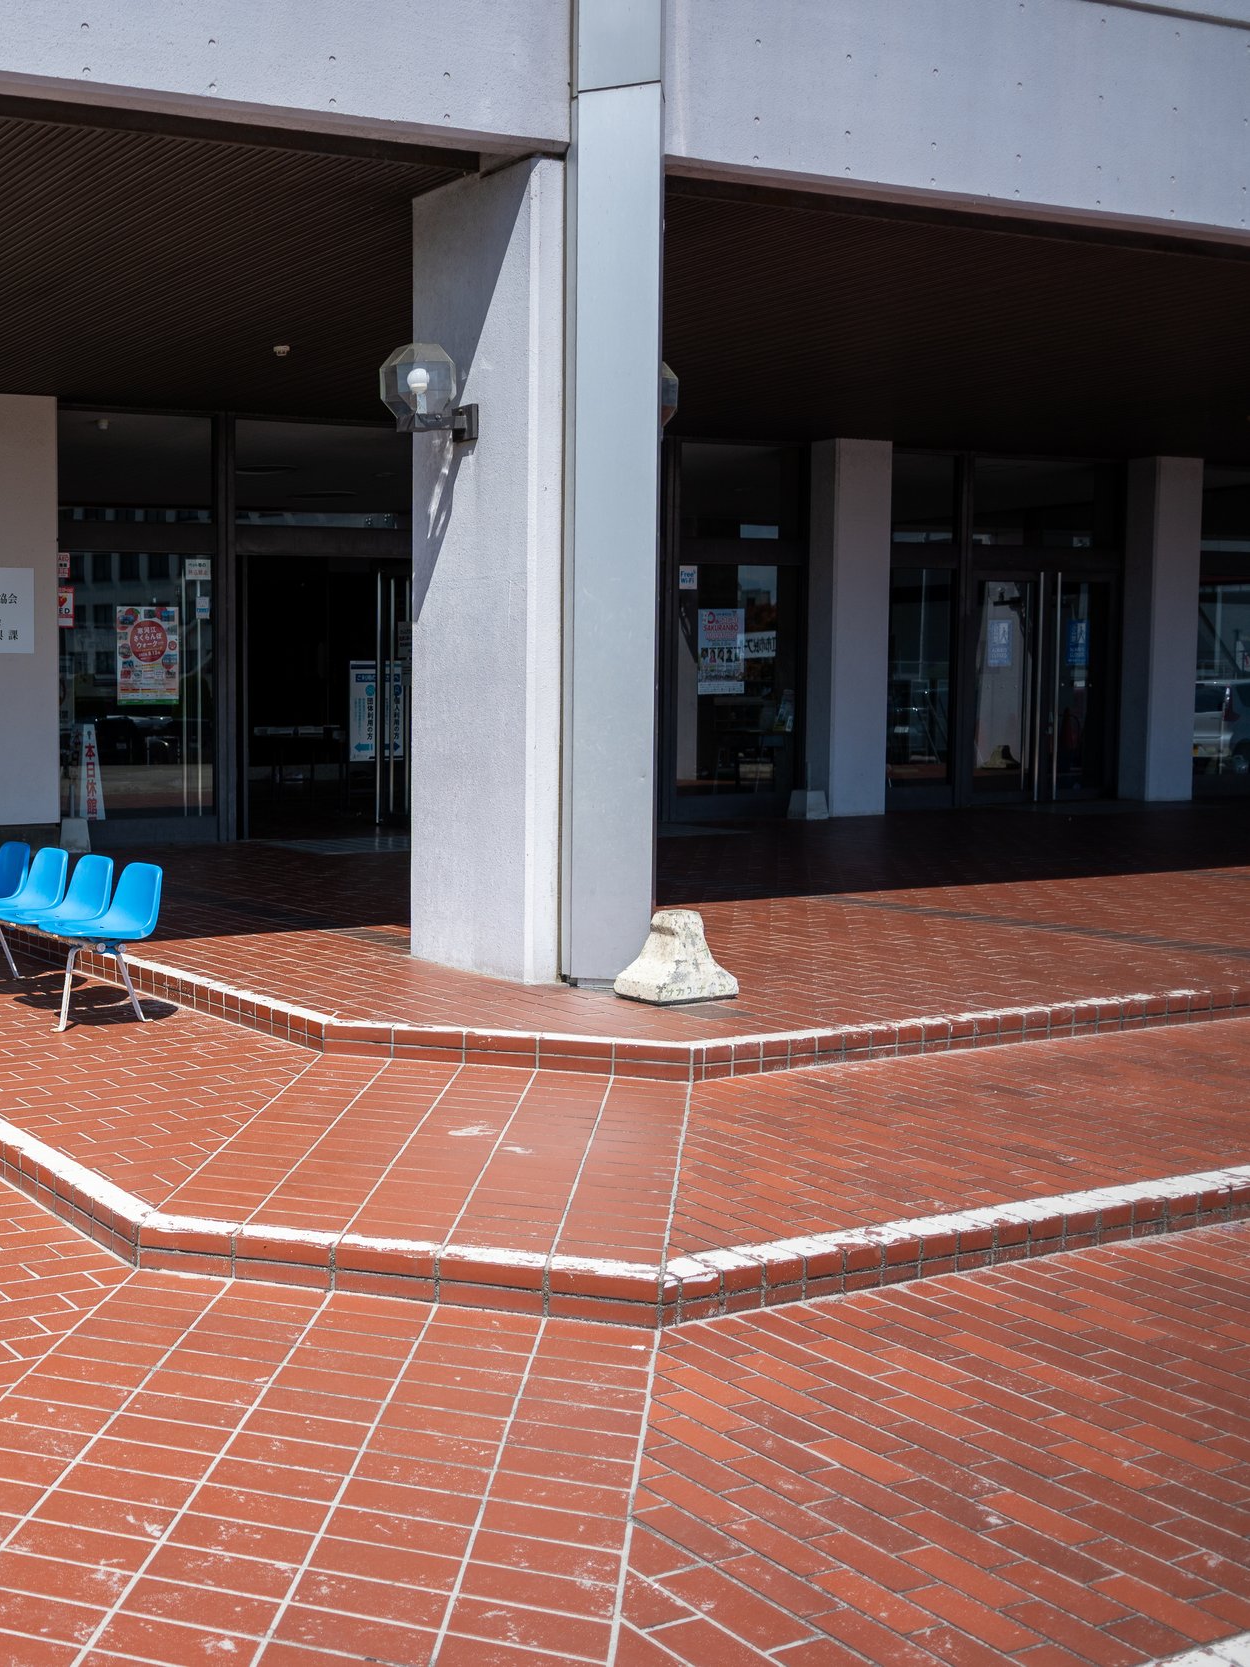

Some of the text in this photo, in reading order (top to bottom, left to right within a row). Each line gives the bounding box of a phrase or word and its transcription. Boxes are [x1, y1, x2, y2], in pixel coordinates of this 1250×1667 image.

[134, 633, 162, 642] さくらんぼ
